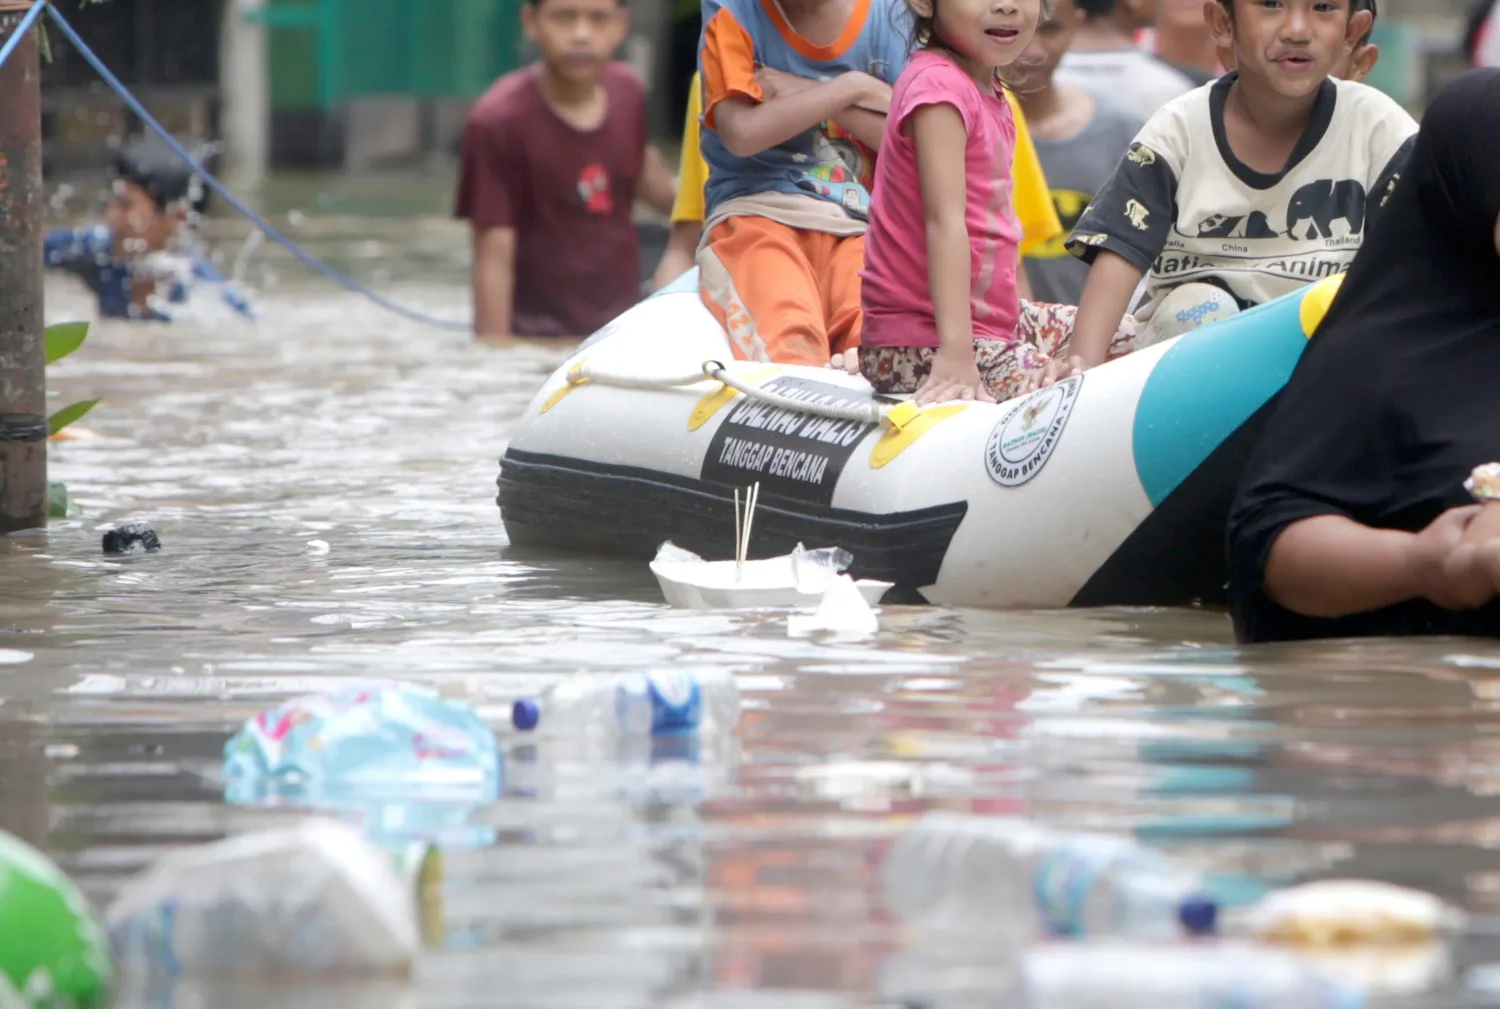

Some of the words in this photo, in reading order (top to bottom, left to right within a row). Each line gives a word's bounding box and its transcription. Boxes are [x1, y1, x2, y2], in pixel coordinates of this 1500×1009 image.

[1221, 243, 1249, 253] China
[1324, 236, 1361, 247] Thailand
[718, 436, 775, 473] TANGGAP
[769, 447, 830, 485] BENCANA
[988, 442, 1020, 480] TANGGAP
[1021, 416, 1065, 476] BENCANA
